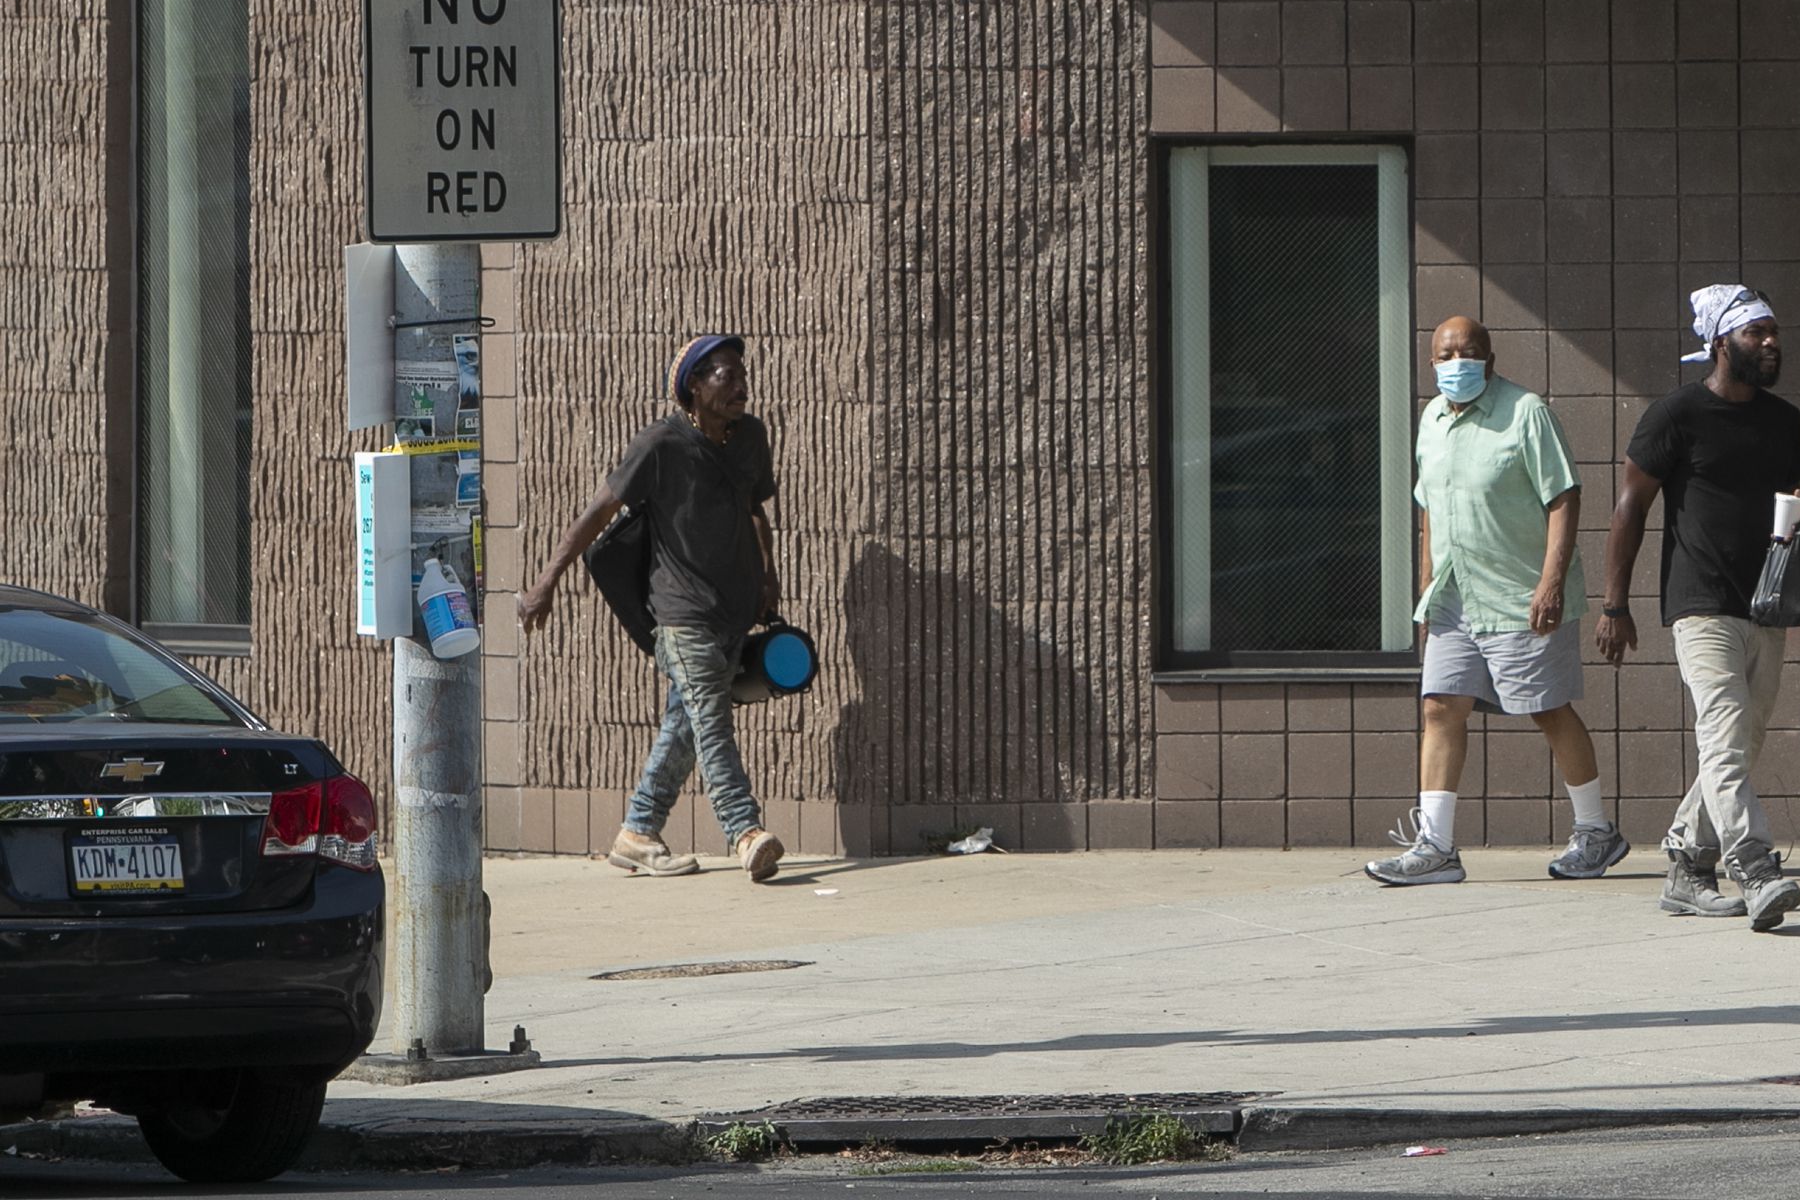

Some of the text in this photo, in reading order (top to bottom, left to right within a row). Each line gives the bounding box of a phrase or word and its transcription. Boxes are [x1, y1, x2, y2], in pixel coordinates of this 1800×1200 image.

[409, 45, 518, 88] TURN
[435, 108, 496, 151] ON
[426, 171, 508, 214] RED
[284, 763, 298, 776] LT
[81, 828, 127, 836] ENTERPRISE
[145, 827, 169, 835] SALES
[96, 835, 154, 844] PENNSYLVANIA
